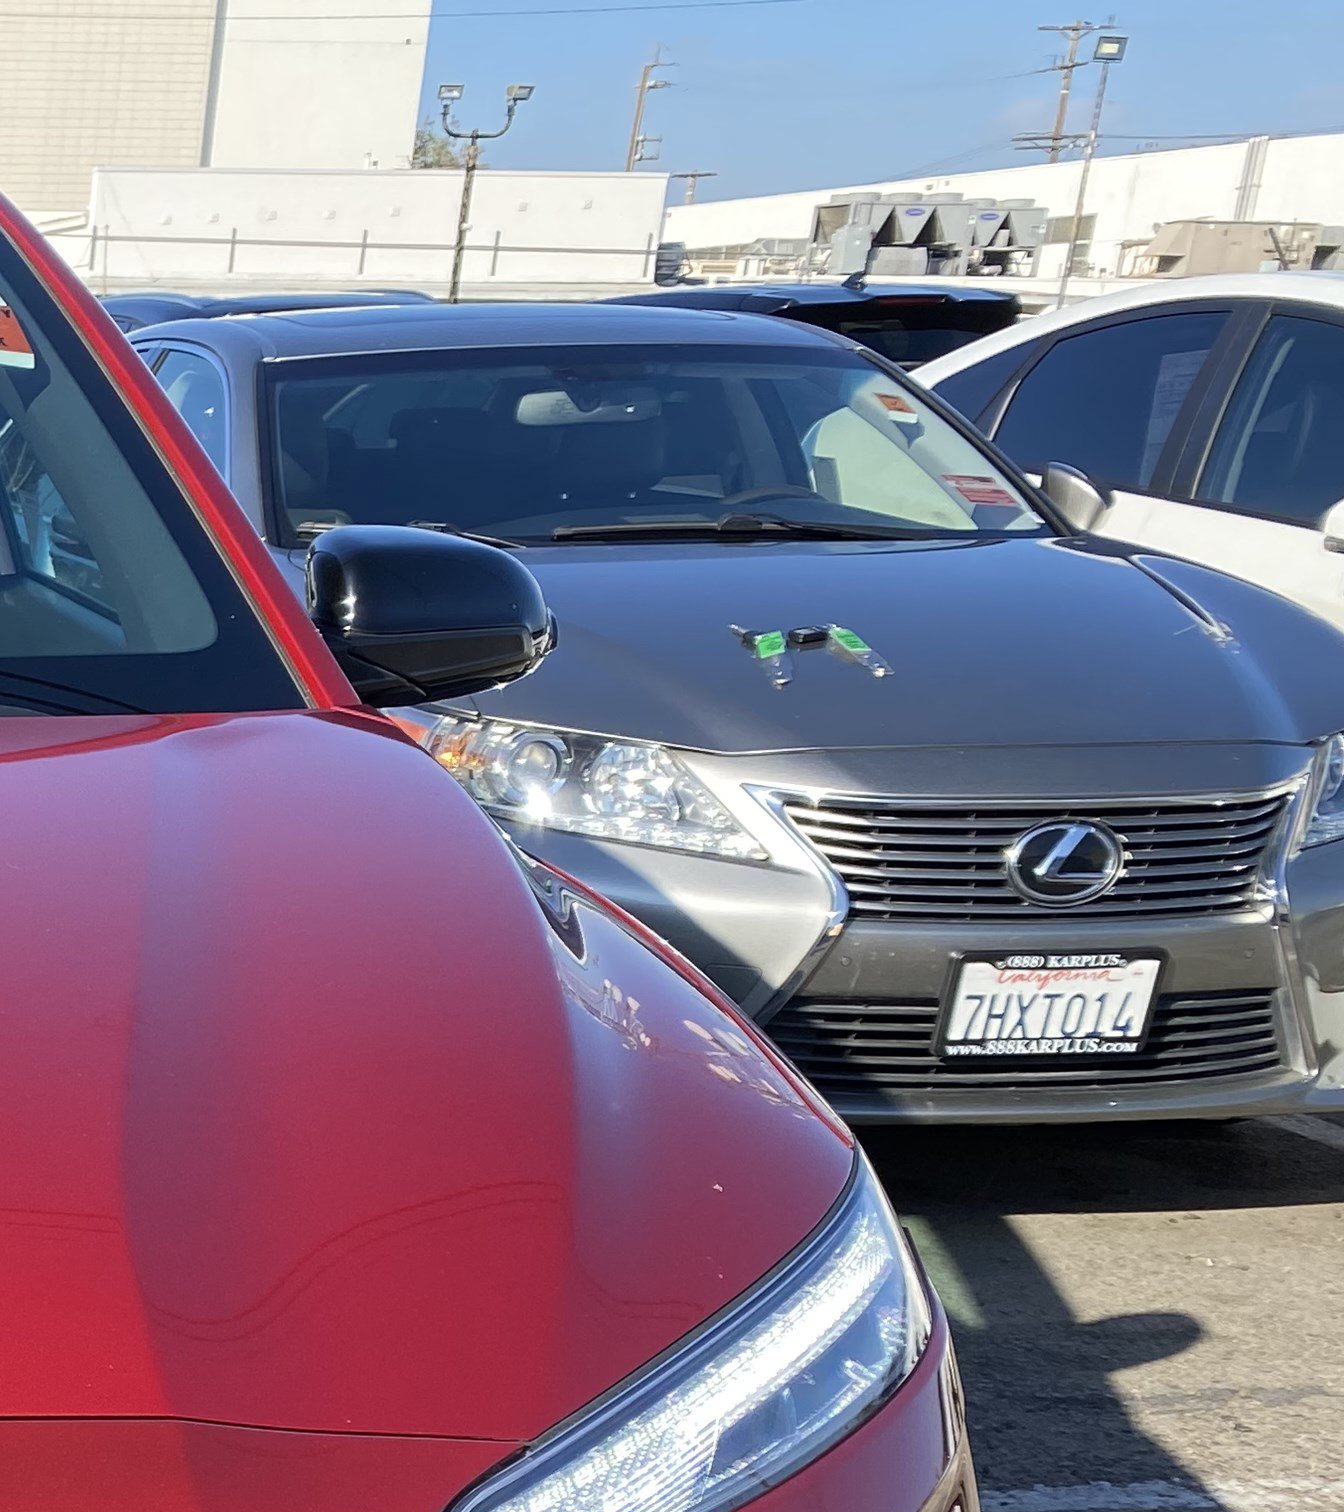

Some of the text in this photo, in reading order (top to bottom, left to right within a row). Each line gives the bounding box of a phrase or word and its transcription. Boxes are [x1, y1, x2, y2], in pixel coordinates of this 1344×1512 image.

[1007, 954, 1122, 968] (888) KARPLUS
[962, 991, 1133, 1039] 7HXT014
